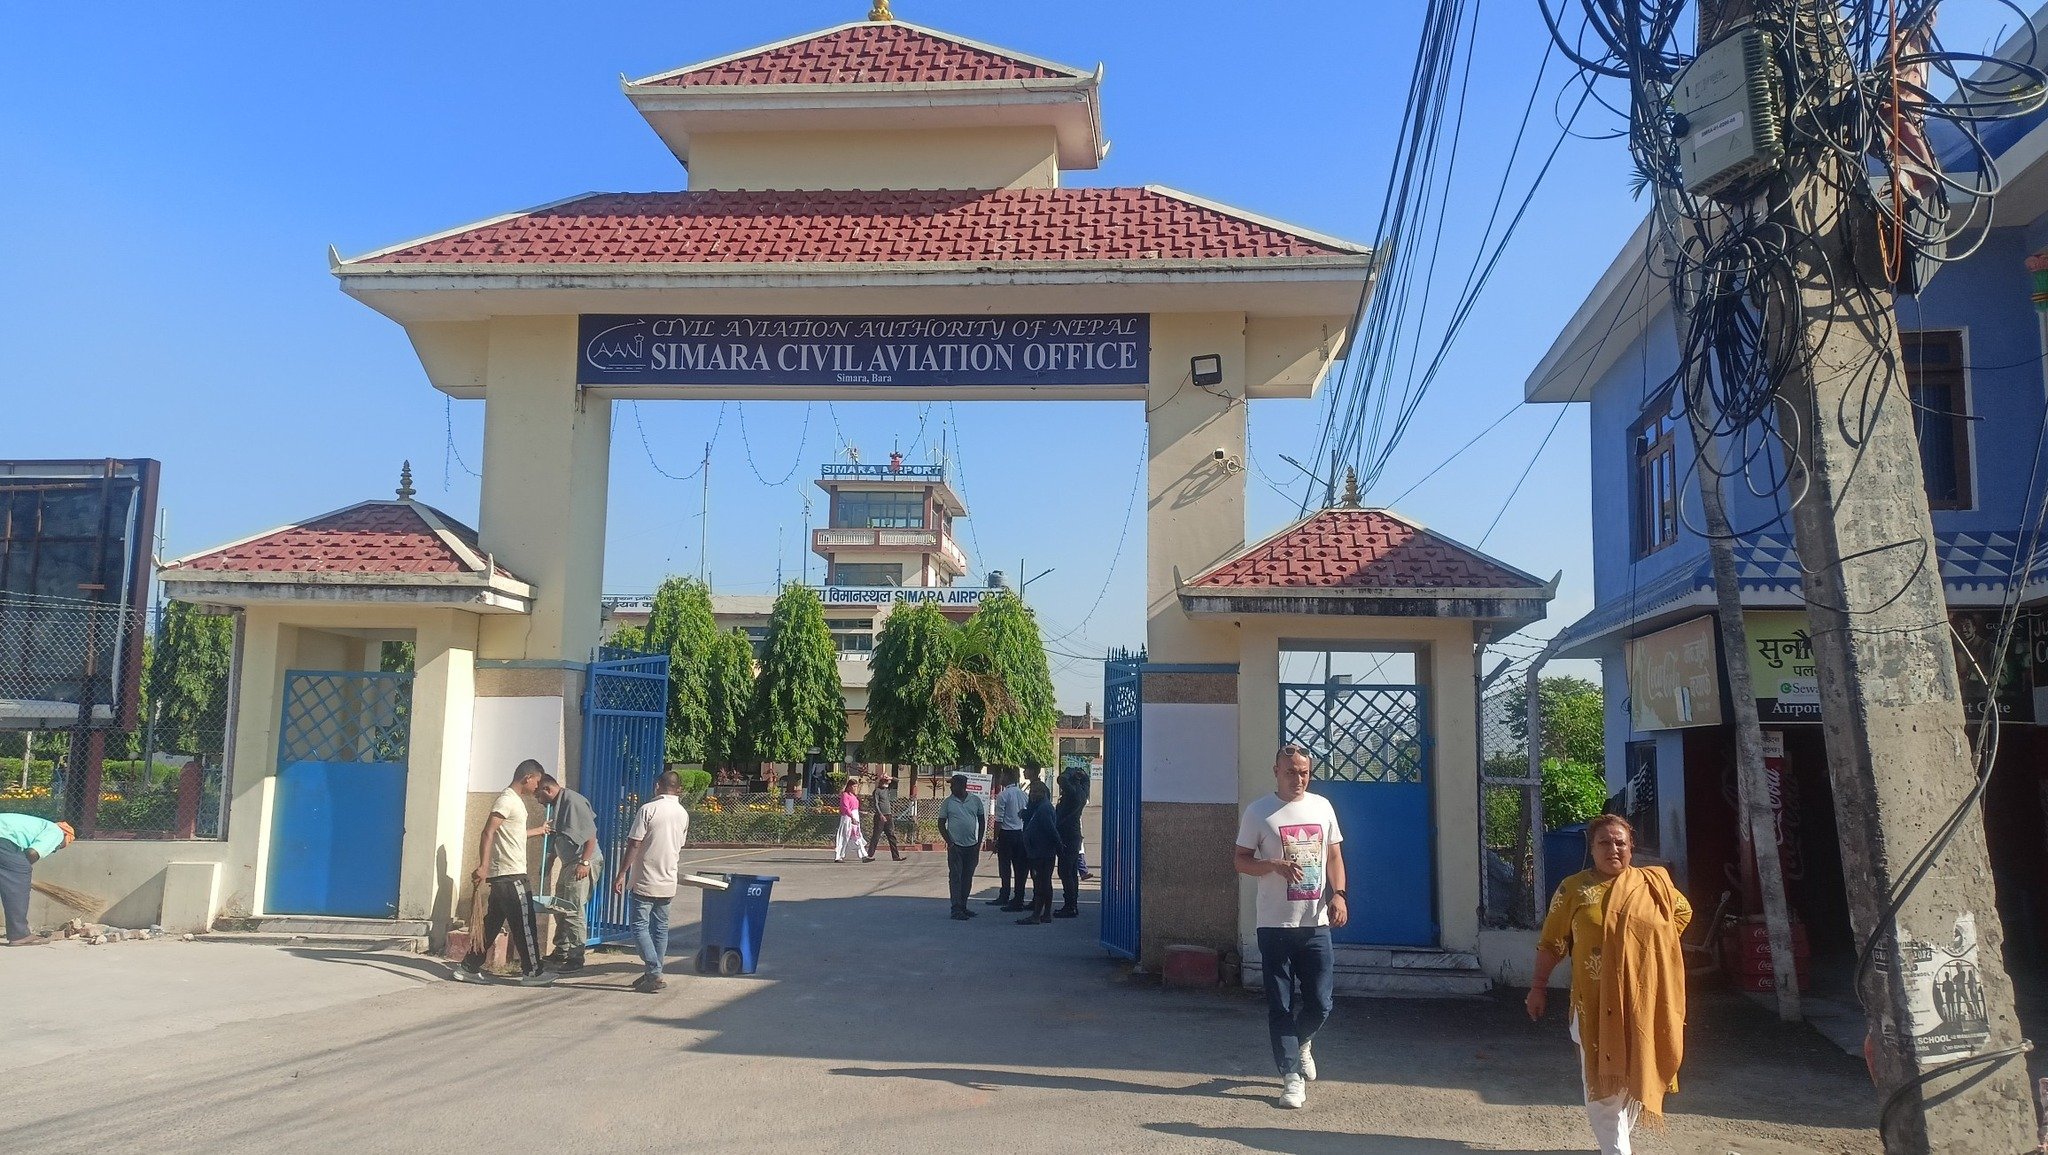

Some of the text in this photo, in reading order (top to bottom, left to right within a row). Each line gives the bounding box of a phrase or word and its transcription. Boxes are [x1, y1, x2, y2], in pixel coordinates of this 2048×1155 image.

[652, 318, 1138, 340] CIVIL AVIATION AUTHORITY OF NEPAL
[650, 341, 1138, 371] SIMARA CIVIL AVIATION OFFICE
[836, 373, 892, 383] Simara, Bara
[823, 465, 877, 474] SIMARA
[829, 587, 893, 603] विमानस्थल
[894, 590, 945, 603] SIMARA
[747, 887, 762, 897] ECO
[1917, 1035, 1952, 1045] SCHOOL
